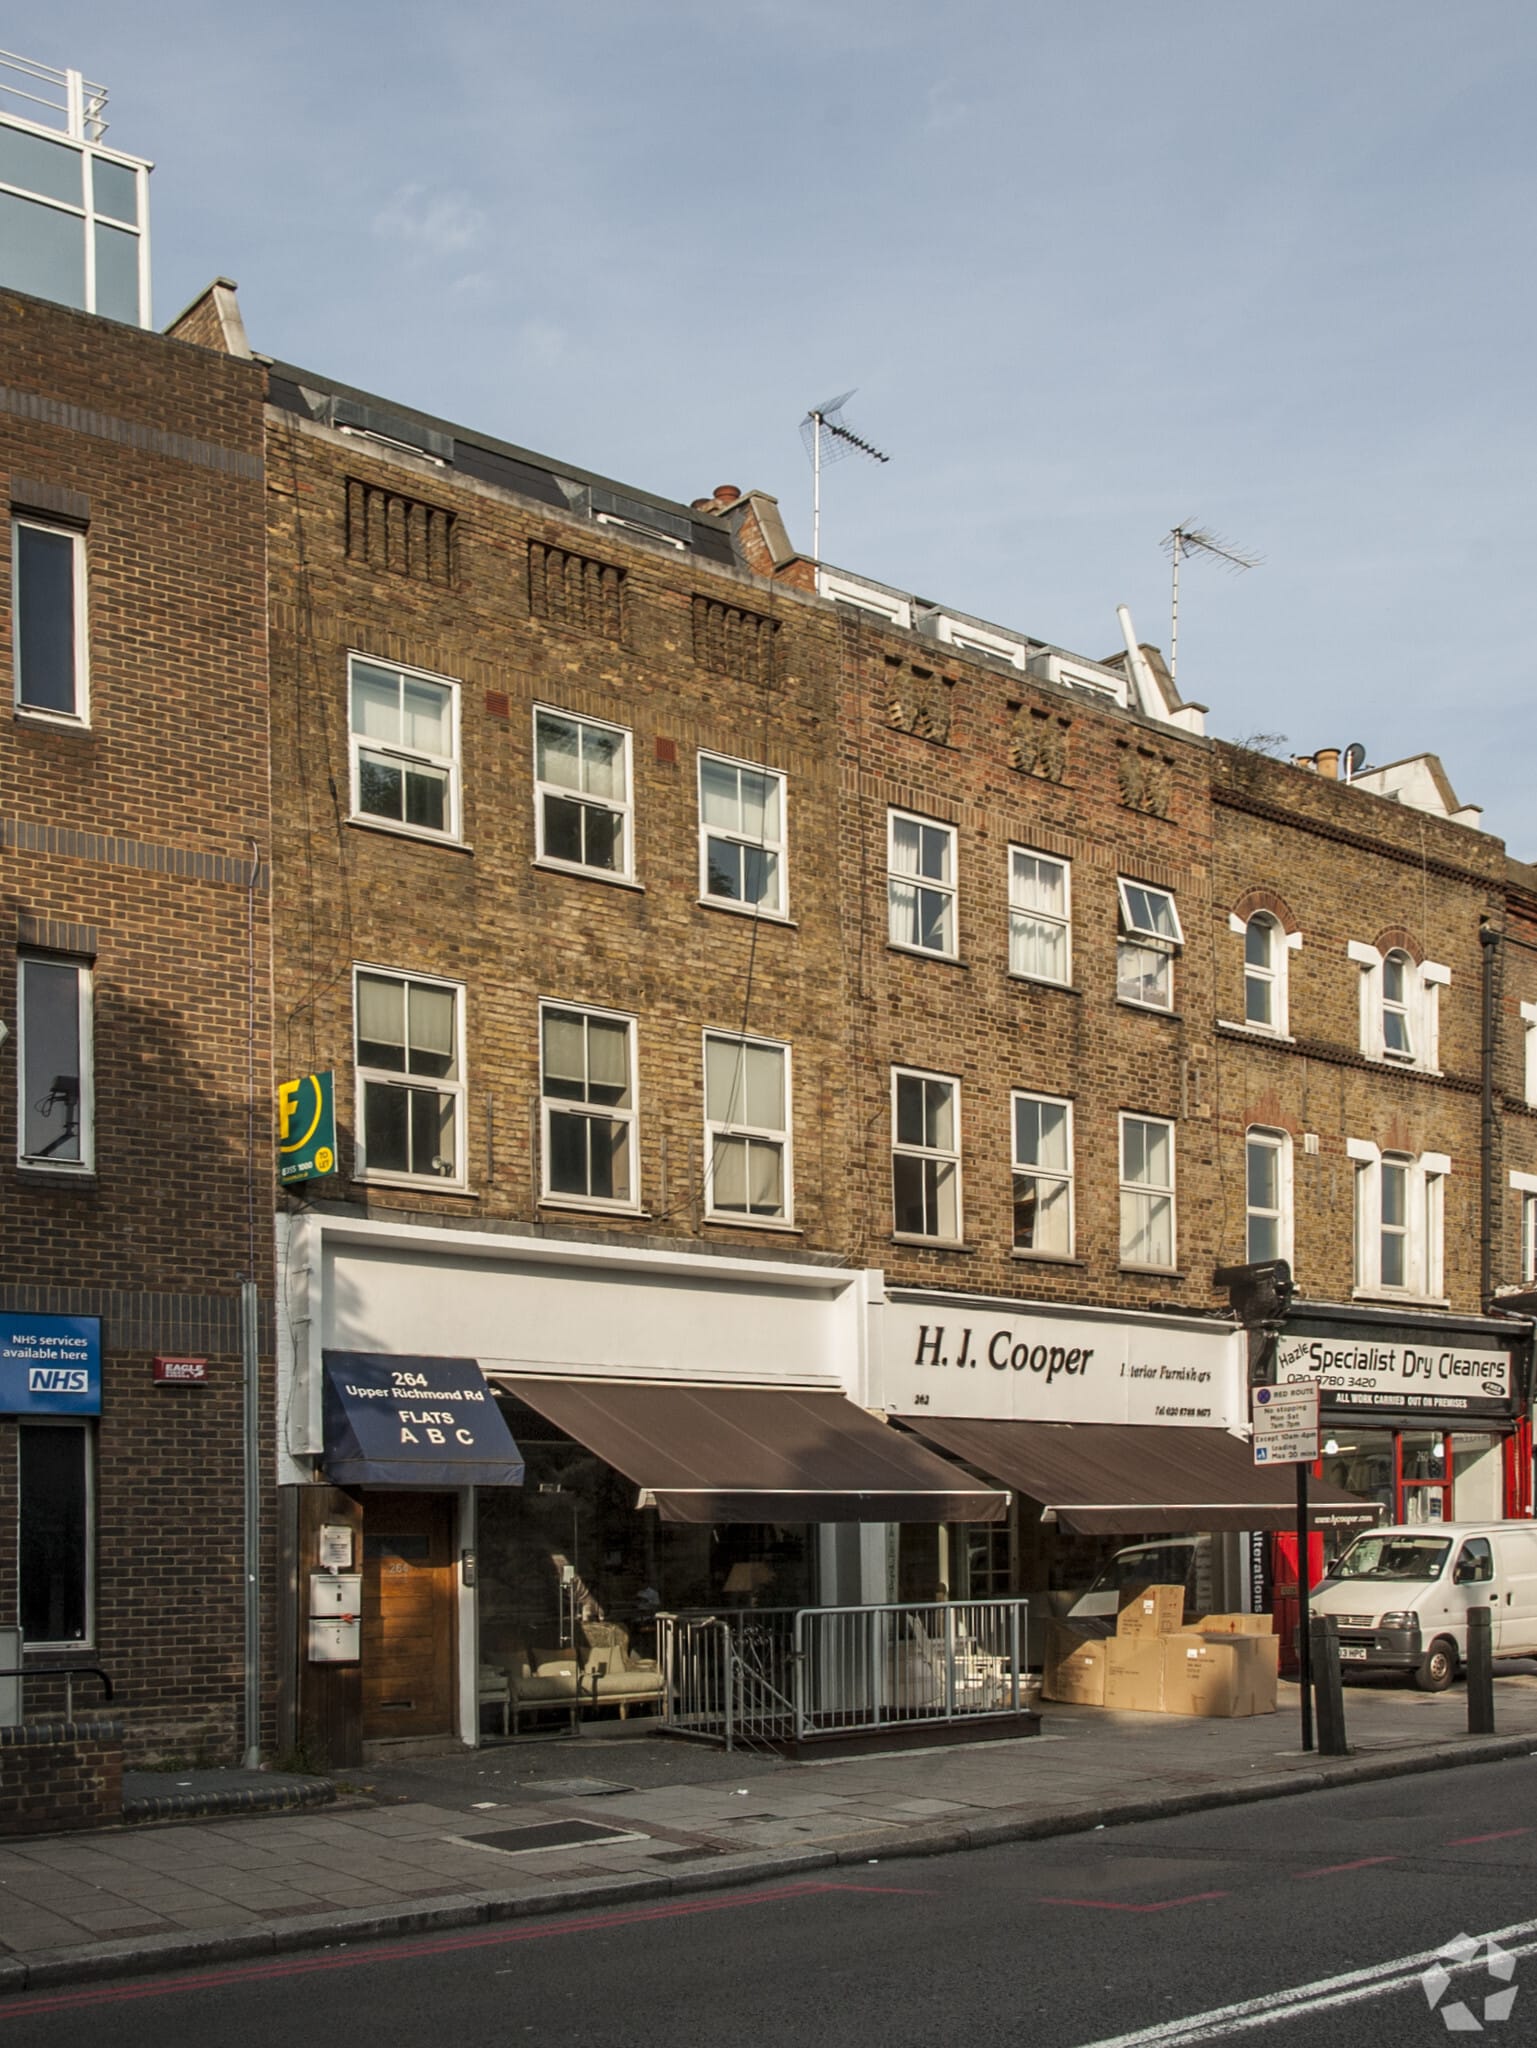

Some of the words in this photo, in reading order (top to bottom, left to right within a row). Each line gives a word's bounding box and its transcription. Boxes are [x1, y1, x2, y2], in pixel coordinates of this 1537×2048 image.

[12, 1335, 37, 1345] NHS
[39, 1336, 88, 1347] services
[2, 1348, 58, 1360] available
[60, 1351, 88, 1360] here
[913, 1325, 948, 1367] H.
[956, 1328, 977, 1369] J.
[988, 1330, 1095, 1384] Cooper
[1278, 1343, 1309, 1369] Hazle
[1309, 1343, 1396, 1374] Specialist
[1402, 1350, 1433, 1379] Dry
[1439, 1353, 1505, 1379] Cleaners
[1120, 1362, 1158, 1378] Iterior
[31, 1370, 85, 1390] NHS
[391, 1372, 428, 1387] 264
[1347, 1377, 1377, 1388] 3420
[345, 1385, 389, 1399] Upper
[392, 1387, 462, 1400] Richmond
[463, 1391, 485, 1401] Rd
[1290, 1388, 1314, 1396] ROUTE
[1335, 1393, 1350, 1403] ALL
[1350, 1393, 1373, 1404] WORK
[1374, 1395, 1406, 1406] CARRIED
[1407, 1396, 1422, 1407] OUT
[1422, 1397, 1433, 1407] ON
[1433, 1397, 1468, 1408] PREMISES
[1276, 1405, 1307, 1413] stopping
[398, 1411, 454, 1425] FLATS
[401, 1428, 420, 1444] A
[425, 1428, 446, 1444] B
[455, 1429, 474, 1445] C
[1255, 1434, 1279, 1443] Except
[1349, 1649, 1366, 1658] HPC
